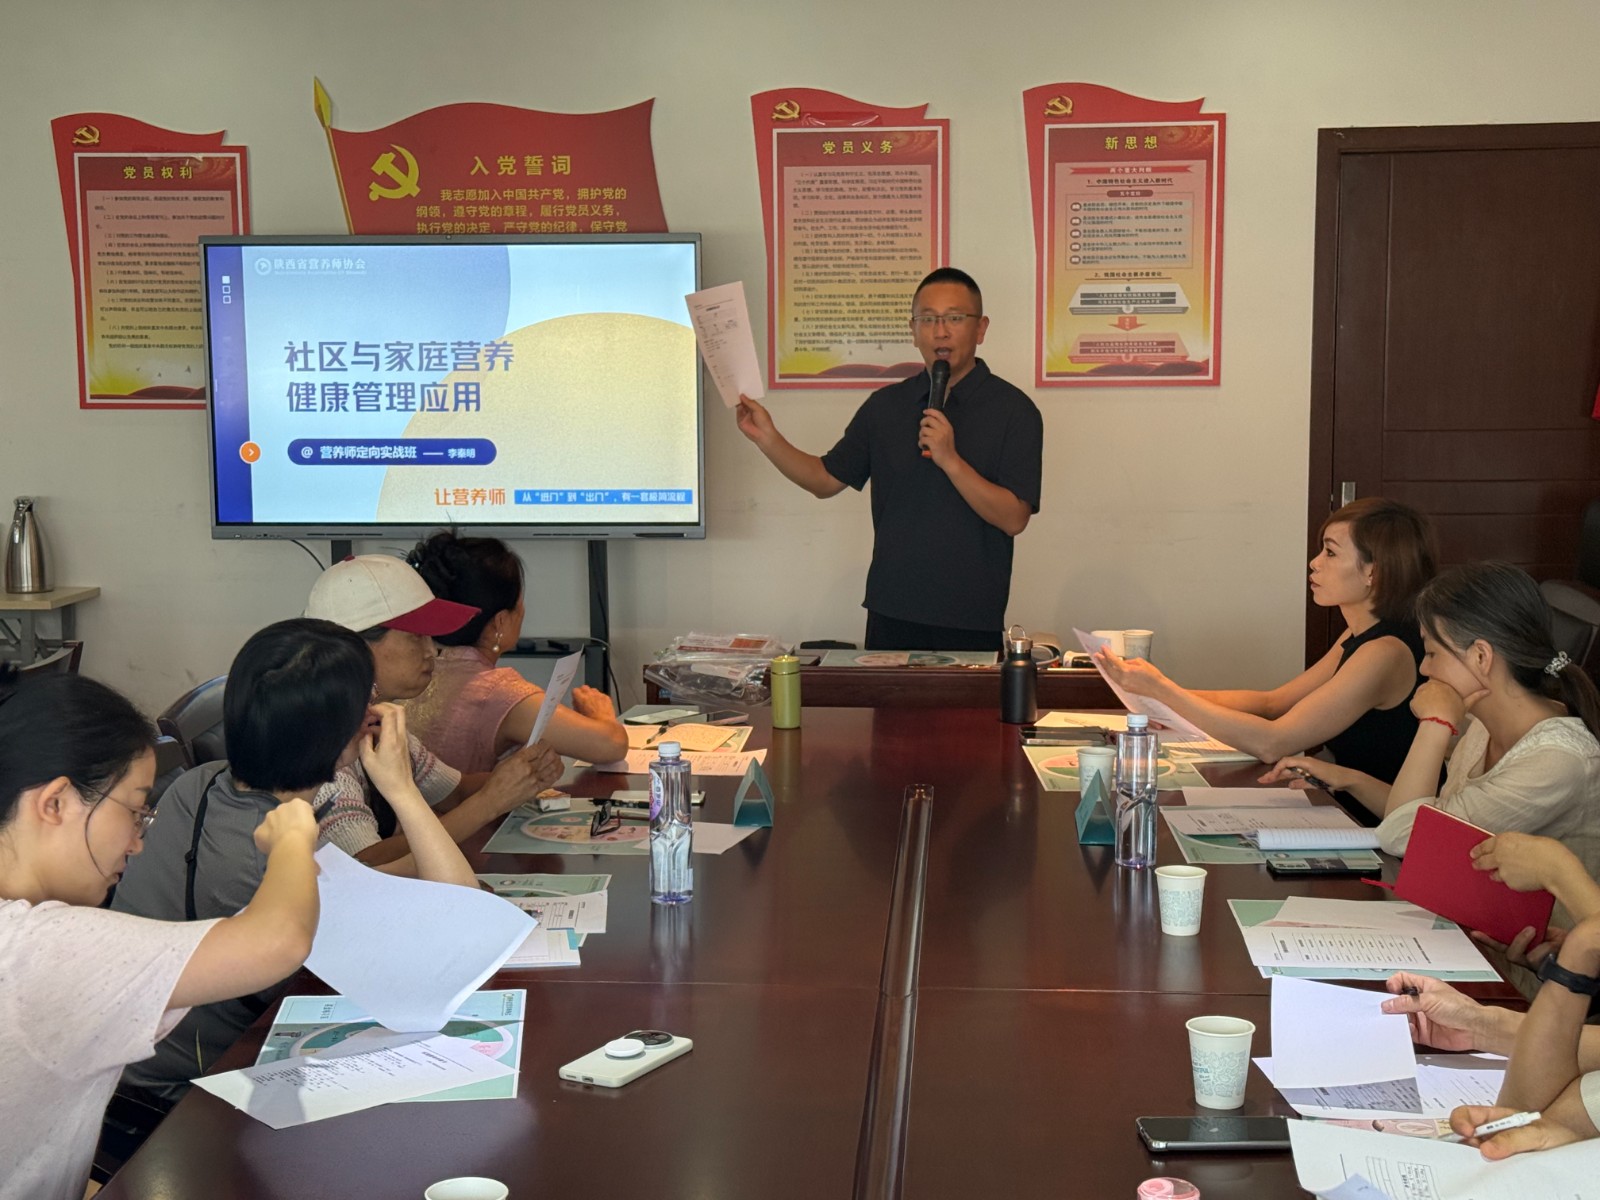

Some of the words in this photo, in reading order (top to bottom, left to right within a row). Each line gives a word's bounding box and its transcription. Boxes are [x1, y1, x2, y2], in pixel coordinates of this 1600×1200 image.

[822, 140, 893, 155] 党员义务
[1105, 136, 1159, 151] 新思想
[123, 165, 193, 180] 党员权利
[470, 155, 571, 176] 入党誓词
[274, 258, 366, 270] 陕西省营养师协会
[284, 340, 514, 372] 社区与家庭营养
[286, 381, 481, 412] 健康管理应用
[320, 446, 417, 459] 营养师定向实战班
[434, 488, 506, 506] 让营养师
